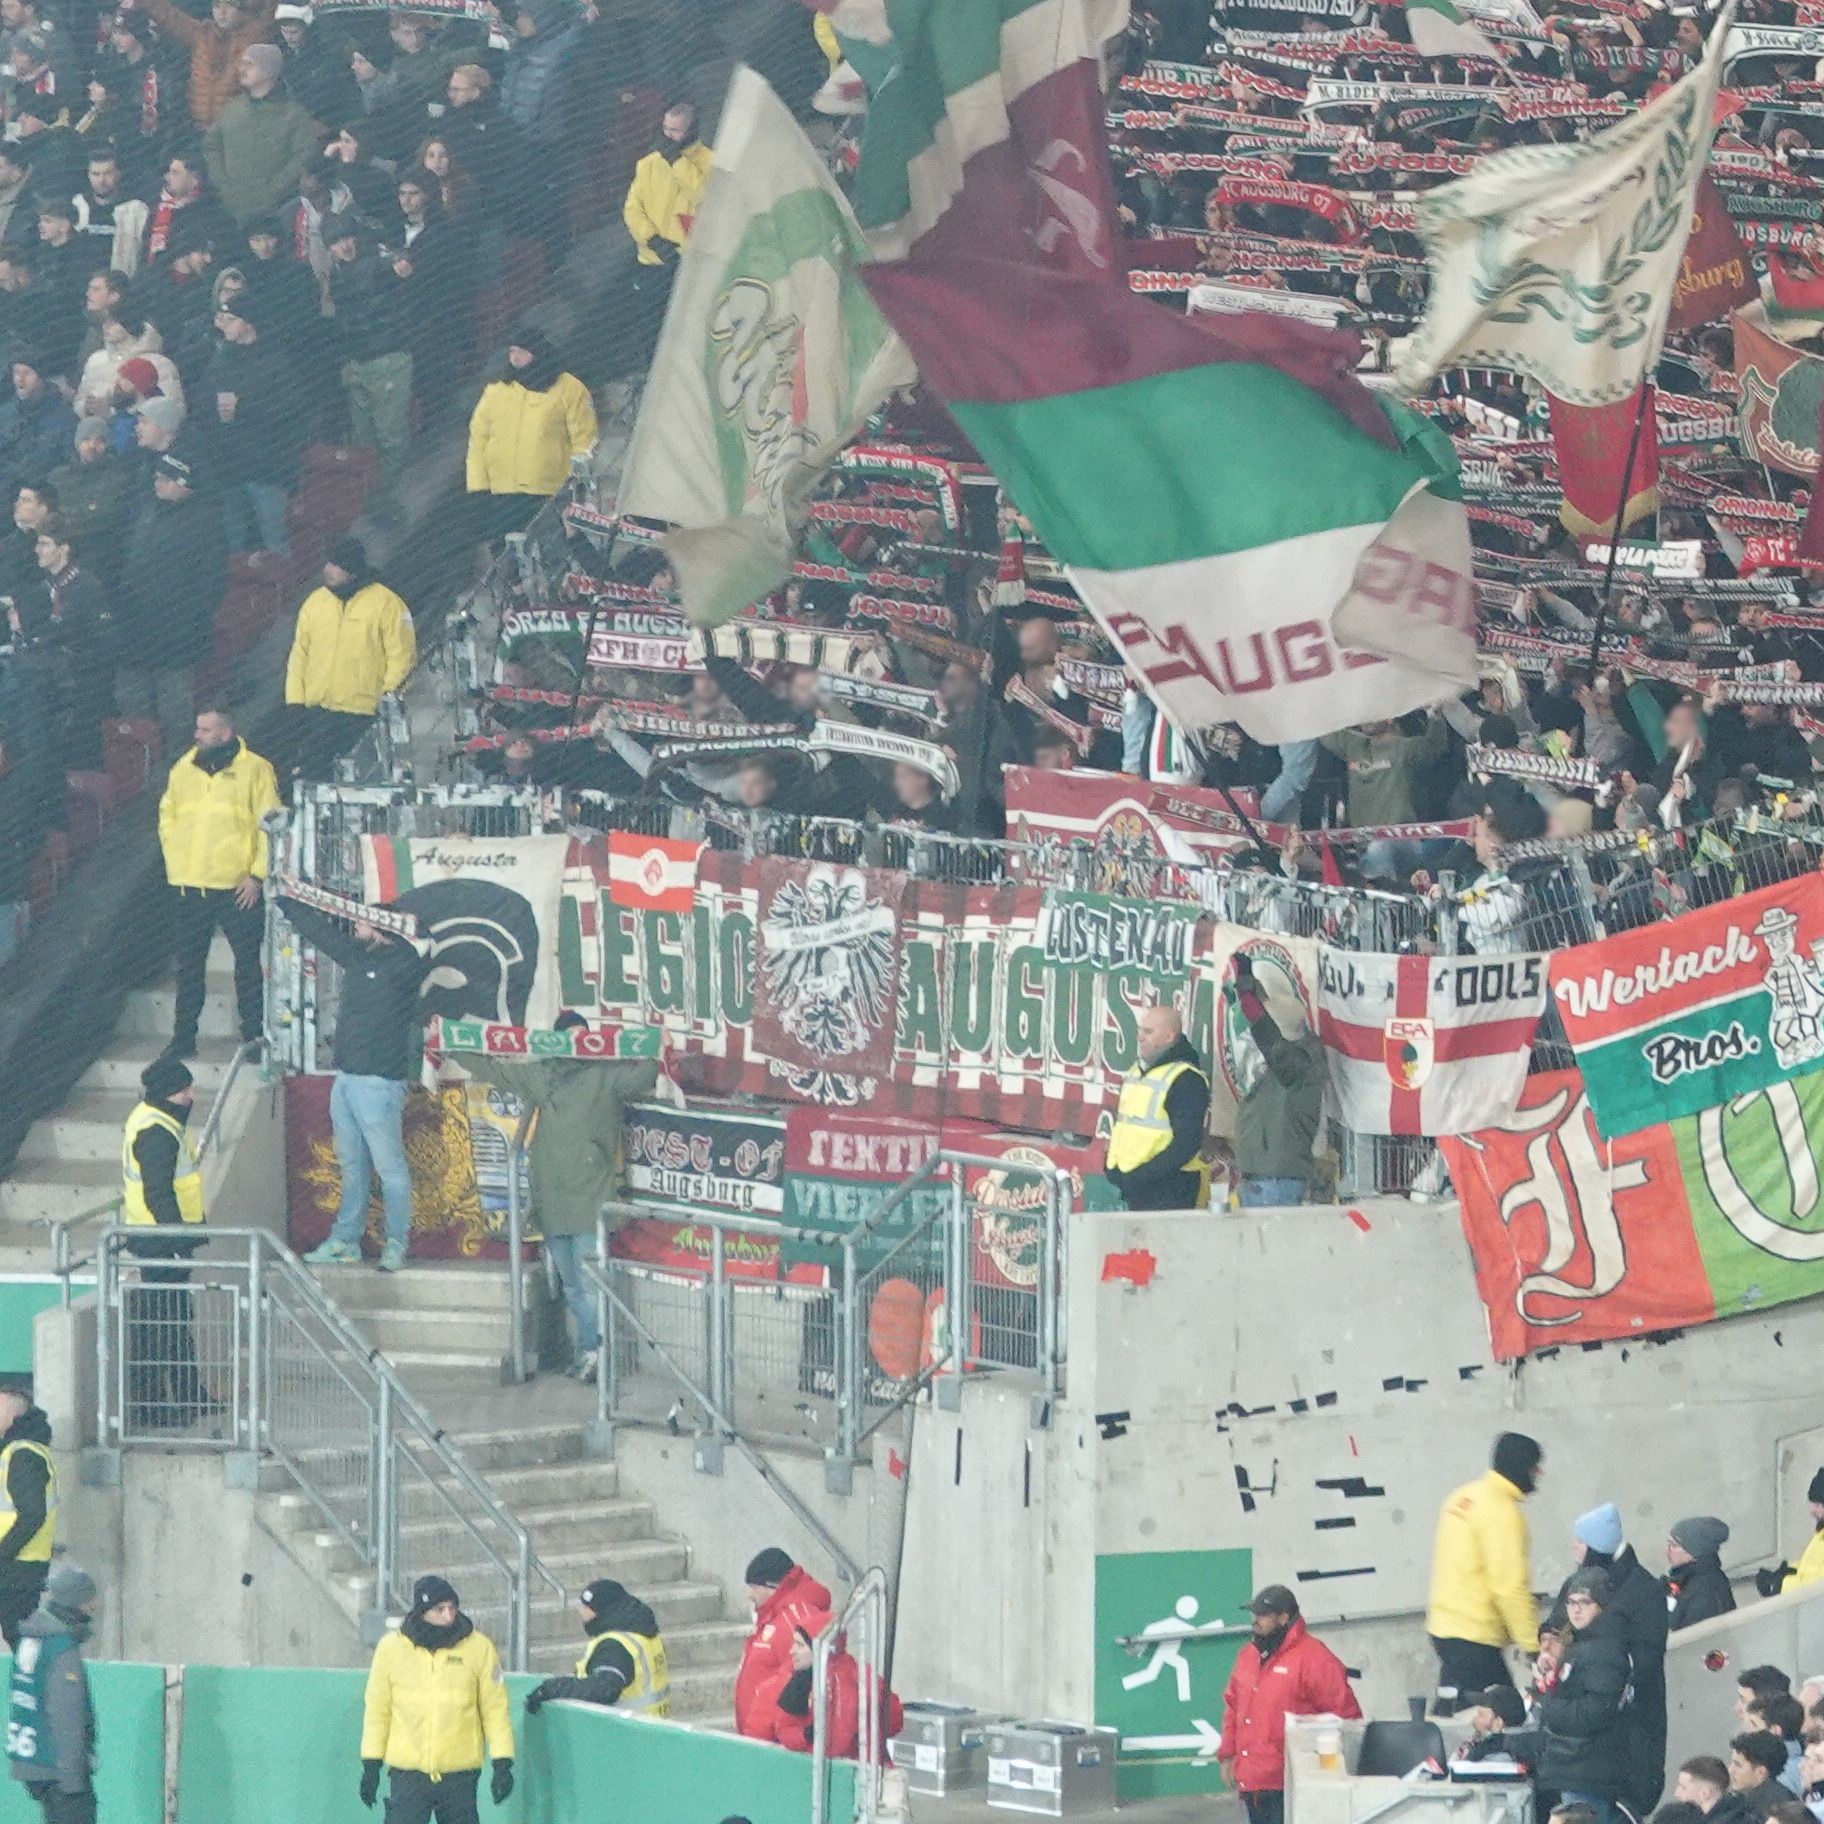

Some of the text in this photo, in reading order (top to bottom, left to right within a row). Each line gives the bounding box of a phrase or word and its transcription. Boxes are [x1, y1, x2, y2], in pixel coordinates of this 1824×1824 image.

[412, 846, 519, 869] Augusta
[560, 886, 758, 1026] LEGIO
[1554, 925, 1759, 1017] Wertach
[1391, 1023, 1428, 1037] FCA
[1642, 1020, 1761, 1086] Bros.
[648, 1166, 756, 1209] Augsburg
